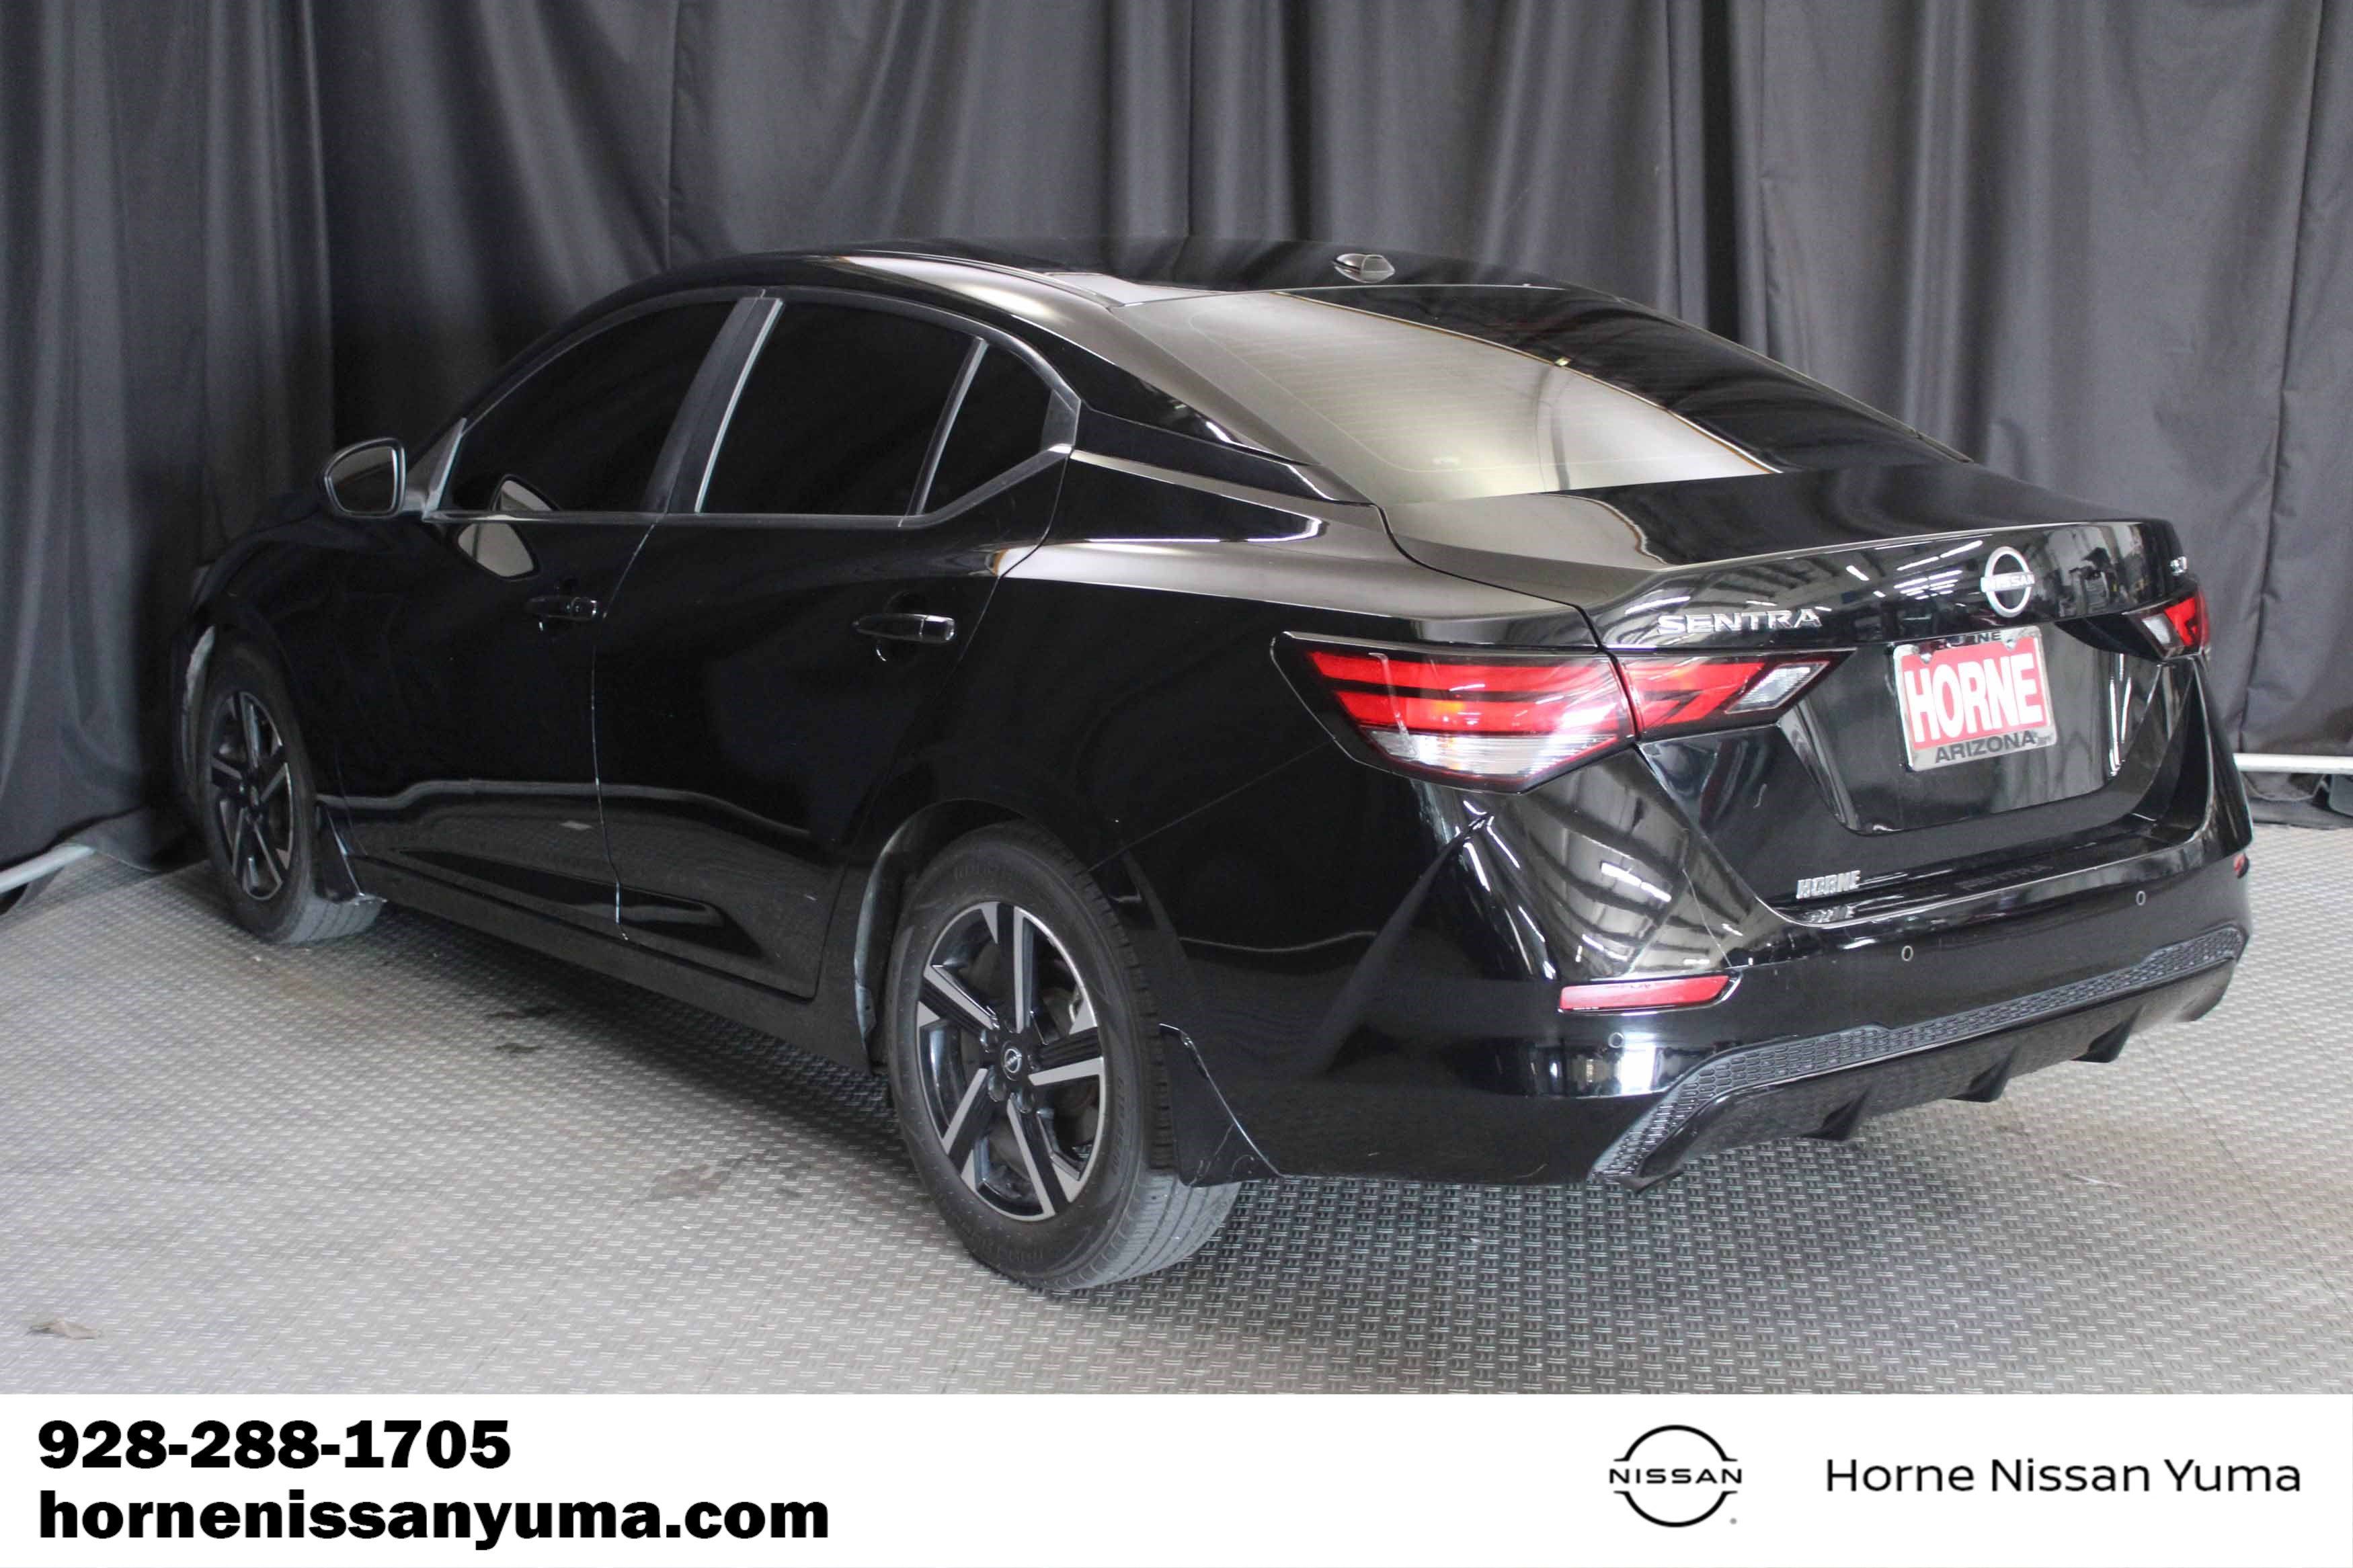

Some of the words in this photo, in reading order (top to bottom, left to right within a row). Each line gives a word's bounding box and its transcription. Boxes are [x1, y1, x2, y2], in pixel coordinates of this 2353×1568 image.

[1985, 573, 2034, 589] NISSAN
[1657, 608, 1823, 634] SENTRA
[1903, 652, 2043, 743] HORNE
[1935, 730, 2036, 764] ARIZONA
[1796, 870, 1861, 899] HORNE
